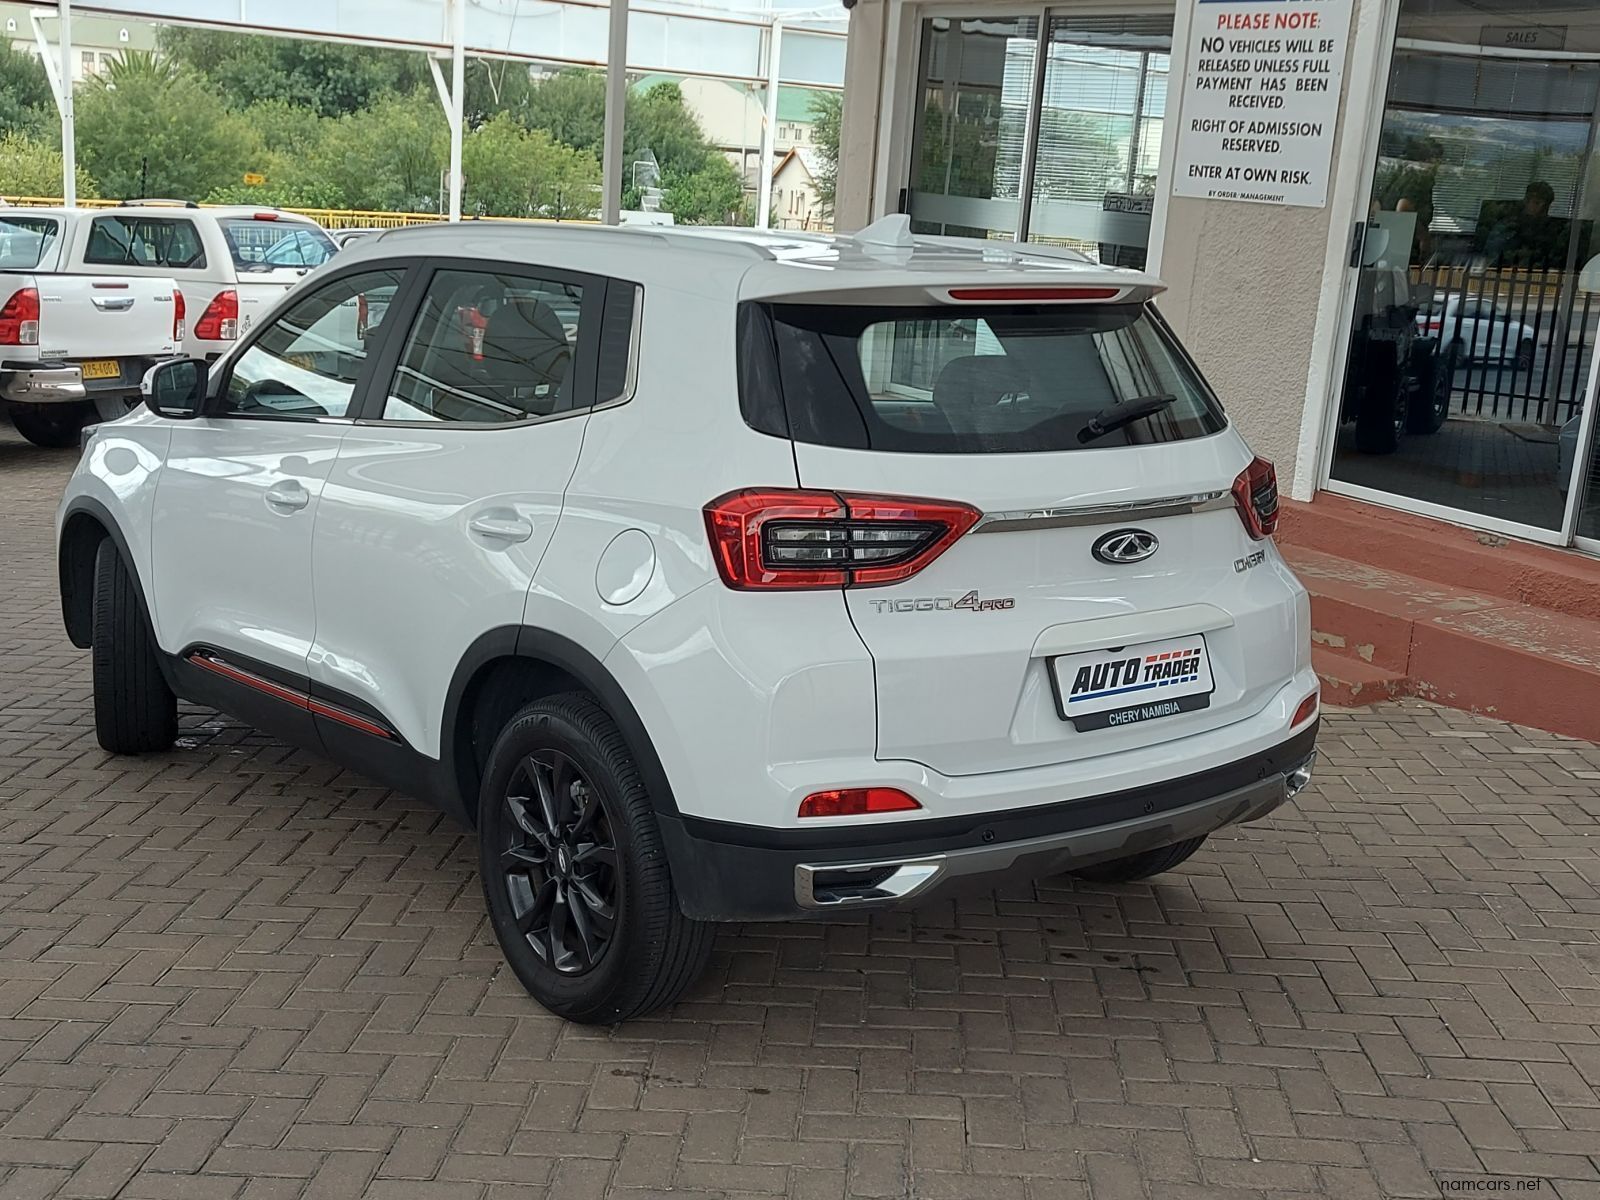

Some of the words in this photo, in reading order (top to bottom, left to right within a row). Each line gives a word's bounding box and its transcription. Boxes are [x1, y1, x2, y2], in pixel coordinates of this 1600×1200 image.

[1217, 13, 1270, 30] PLEASE
[1274, 12, 1321, 30] NOTE:
[1200, 37, 1224, 54] NO
[1229, 39, 1281, 54] VEHICLES
[1286, 39, 1314, 54] WILL
[1318, 39, 1334, 53] BE
[1505, 32, 1538, 43] SALES
[1198, 59, 1250, 73] RELEASED
[1254, 59, 1299, 73] UNLESS
[1302, 60, 1330, 73] FULL
[1196, 77, 1252, 91] PAYMENT
[1260, 78, 1286, 91] HAS
[1295, 78, 1328, 92] BEEN
[1229, 94, 1286, 109] RECEIVED.
[1191, 119, 1226, 133] RIGHT
[1228, 120, 1245, 134] OF
[1247, 121, 1322, 136] ADMISSION
[1222, 138, 1282, 154] RESERVED.
[1189, 165, 1222, 179] ENTER
[1225, 166, 1240, 180] AT
[1243, 168, 1277, 183] OWN
[1280, 170, 1312, 185] RISK.
[1217, 190, 1238, 198] ORDER
[1240, 192, 1285, 202] MANAGEMENT
[868, 597, 953, 614] TIGGO
[1070, 657, 1142, 695] AUTO
[1143, 656, 1200, 682] TRADER
[1108, 709, 1141, 726] CHERY
[1141, 701, 1181, 719] NAMIBIA
